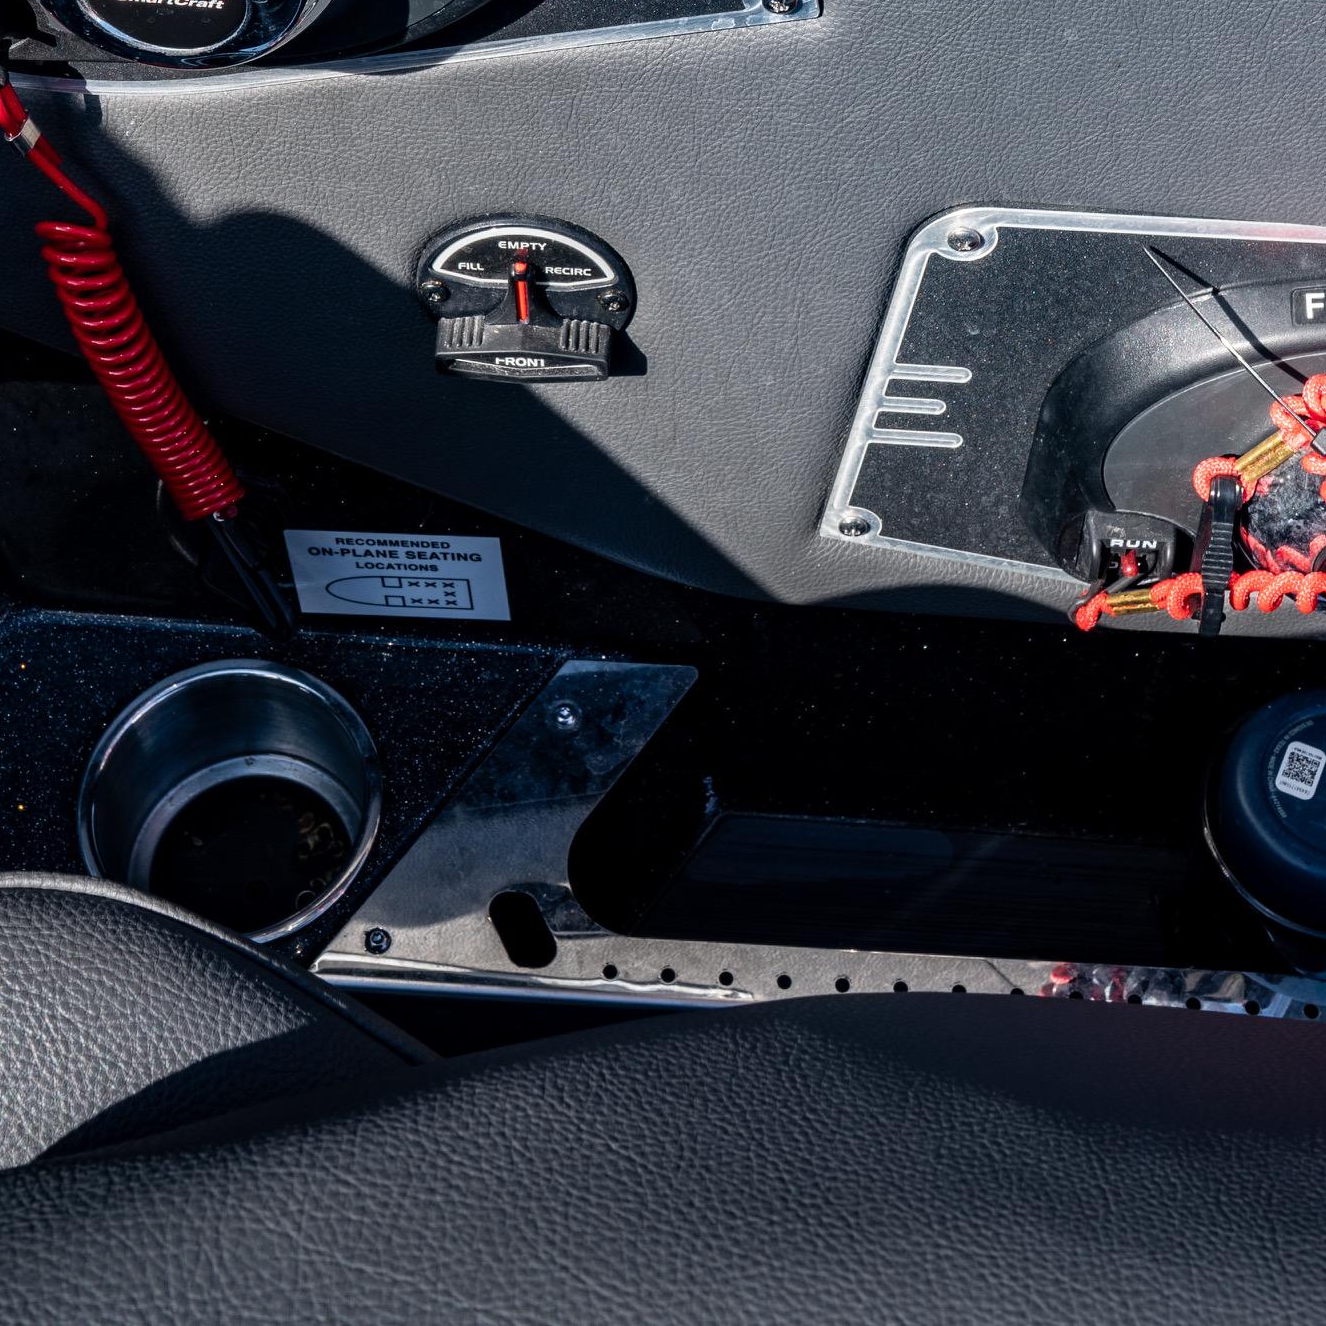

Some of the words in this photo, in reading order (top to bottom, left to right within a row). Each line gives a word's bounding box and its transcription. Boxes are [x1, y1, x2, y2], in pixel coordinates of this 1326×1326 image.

[498, 241, 547, 251] EMPTY
[458, 262, 485, 271] FILL
[545, 266, 592, 276] RECIRC
[1305, 292, 1325, 319] F
[335, 537, 451, 550] RECOMMENDED
[1110, 539, 1157, 549] RUN
[308, 547, 400, 559] ON-PLANE
[405, 550, 483, 563] SEATING
[355, 561, 439, 572] LOCATIONS
